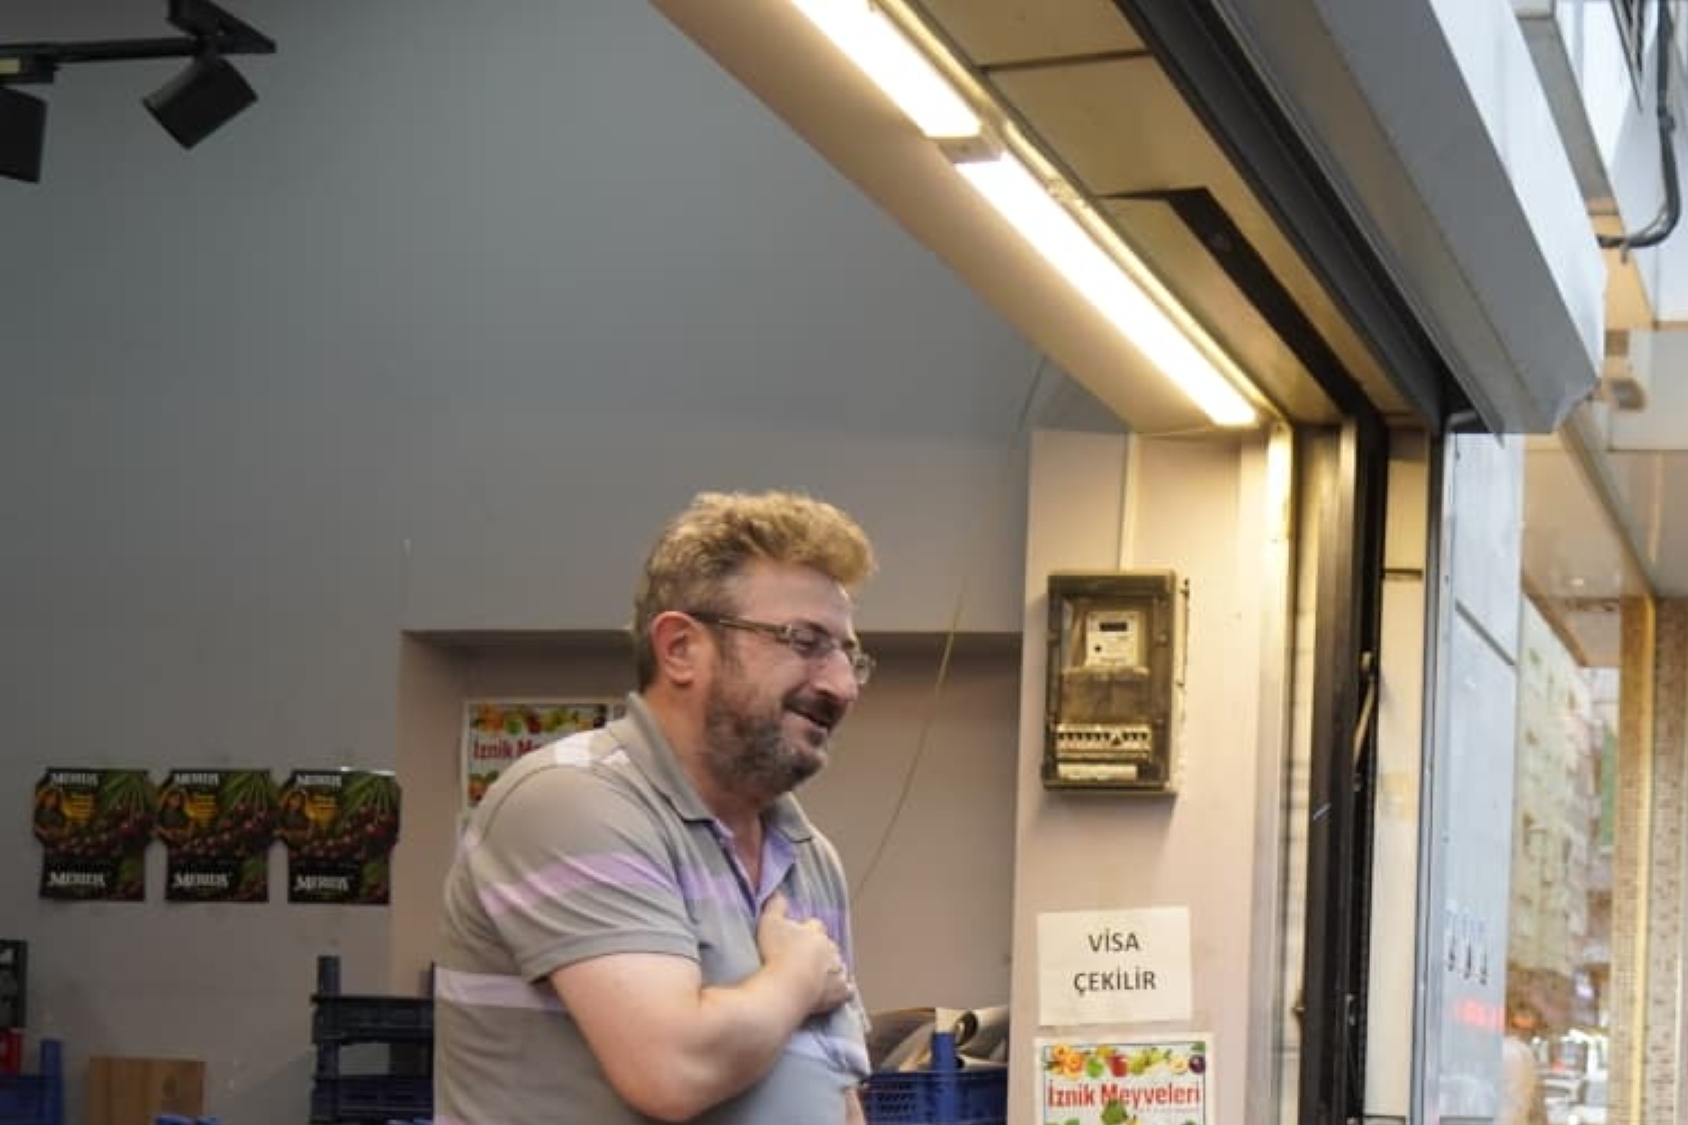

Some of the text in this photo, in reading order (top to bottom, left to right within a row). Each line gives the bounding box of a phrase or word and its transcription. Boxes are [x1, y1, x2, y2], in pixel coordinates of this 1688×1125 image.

[1088, 927, 1141, 953] VİSA
[1073, 965, 1157, 996] ÇEKİLİR
[1100, 1080, 1201, 1109] Meyveleri
